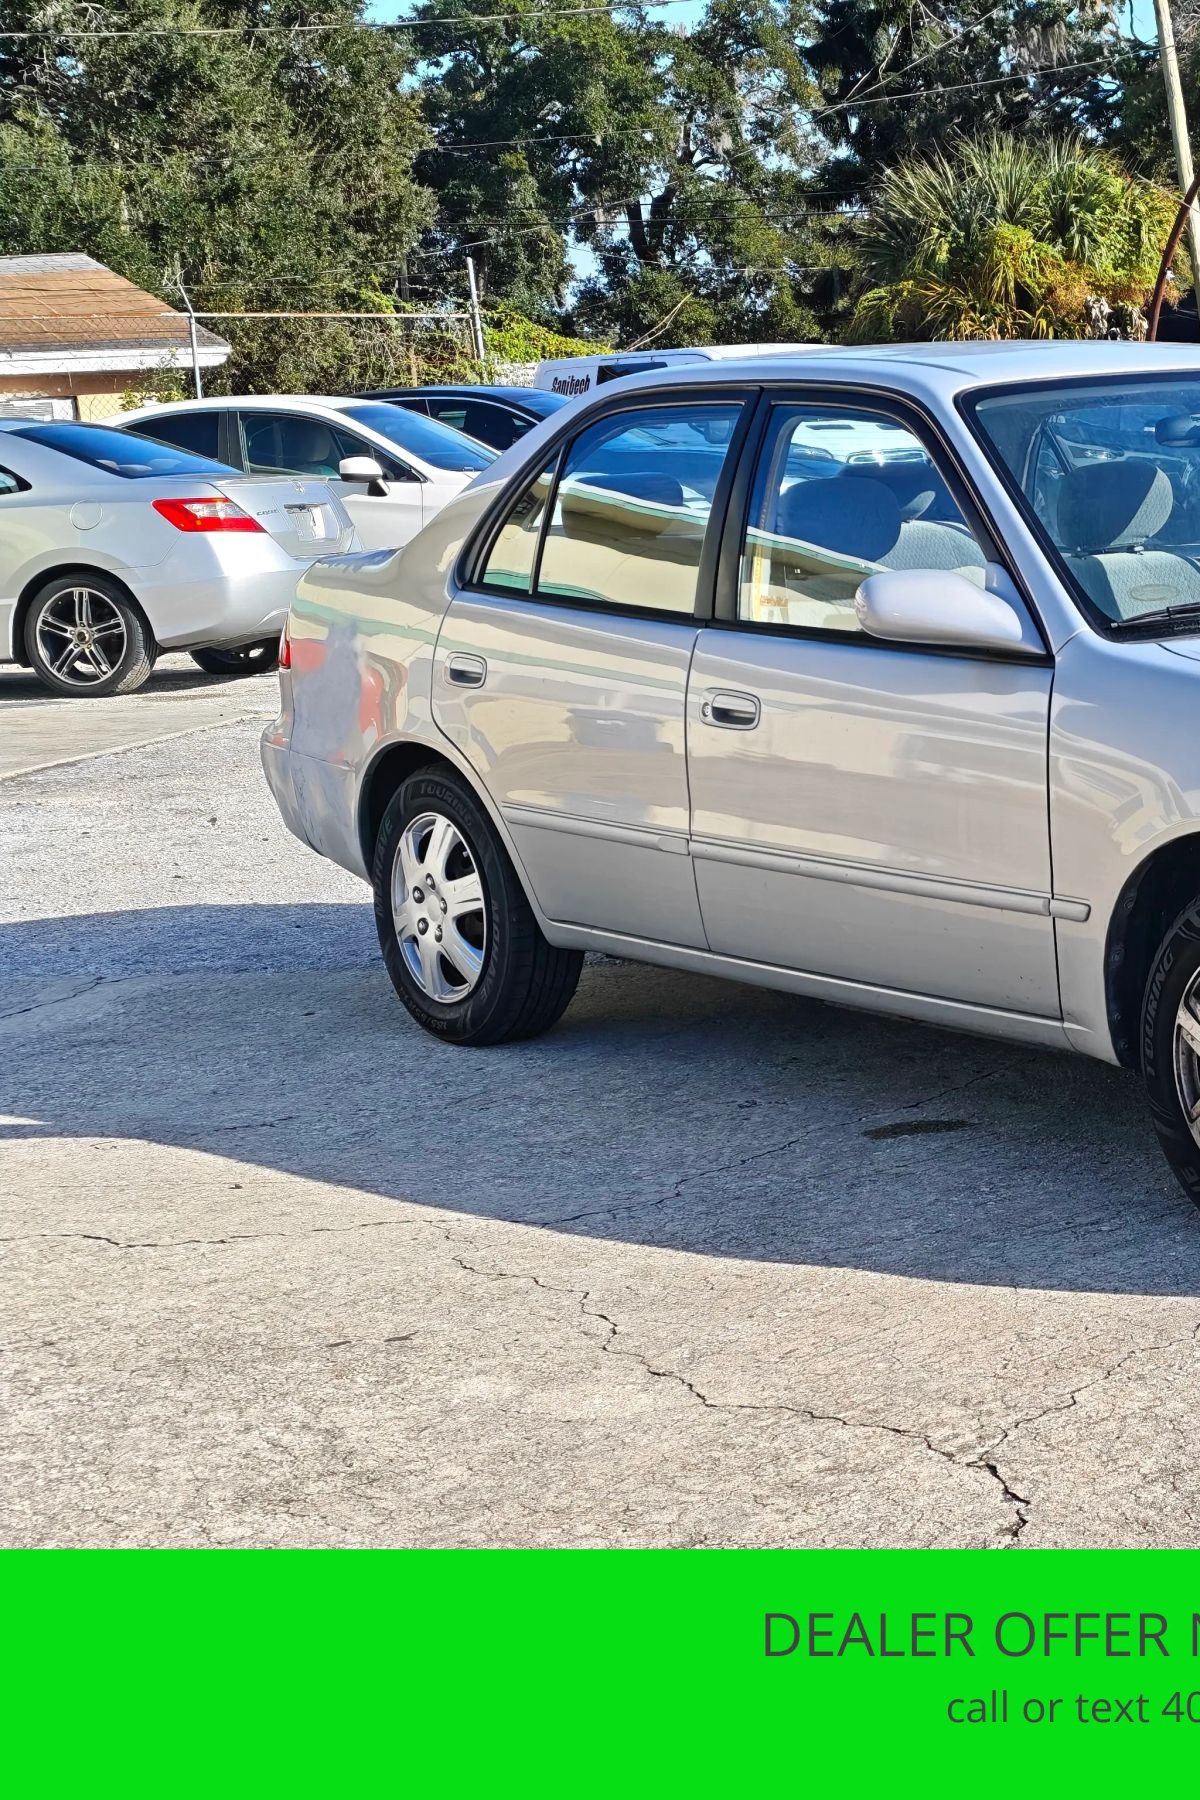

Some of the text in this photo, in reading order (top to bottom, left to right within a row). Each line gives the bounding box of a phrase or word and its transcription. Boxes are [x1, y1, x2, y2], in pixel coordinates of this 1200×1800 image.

[551, 374, 591, 396] Sanitech
[420, 782, 473, 827] TOURING
[1144, 950, 1175, 1078] TOURING
